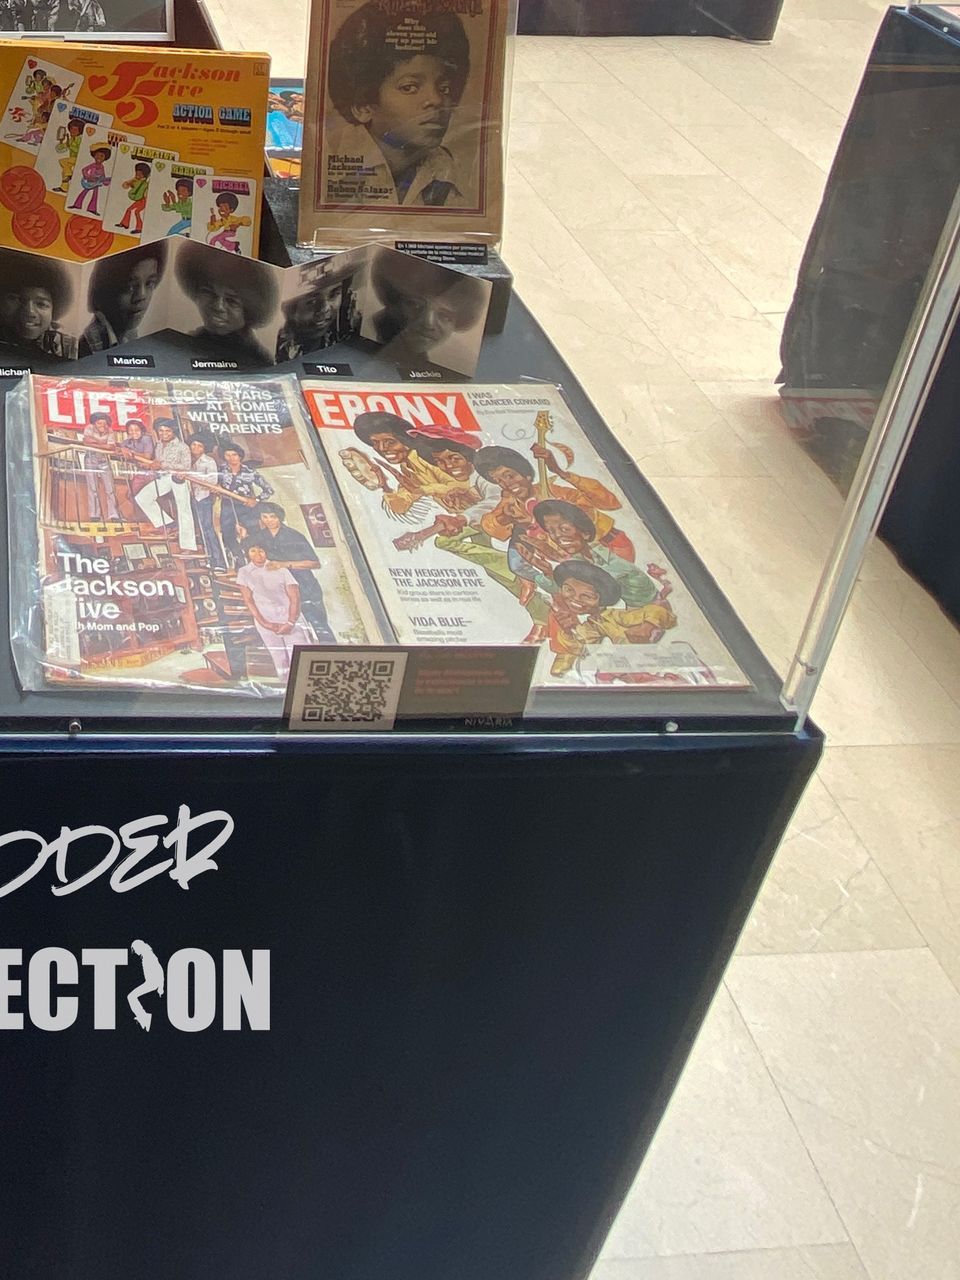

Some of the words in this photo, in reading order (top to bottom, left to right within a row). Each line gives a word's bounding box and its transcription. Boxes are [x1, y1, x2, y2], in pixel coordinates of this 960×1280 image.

[172, 103, 215, 125] ACTION
[218, 106, 252, 128] GAME
[327, 154, 364, 164] Michael
[113, 356, 148, 366] Marlon
[192, 360, 238, 369] Jermaine
[316, 365, 338, 374] Tito
[409, 370, 442, 379] Jackie
[173, 389, 218, 401] ROCK
[222, 390, 273, 401] STARS
[47, 388, 143, 426] LIFE
[206, 401, 224, 411] AT
[230, 401, 277, 412] HOME
[480, 399, 514, 407] CANCER
[312, 393, 462, 429] EBONY
[187, 411, 229, 422] WITH
[233, 412, 280, 423] THEIR
[210, 423, 283, 434] PARENTS
[57, 552, 110, 574] The
[388, 568, 413, 577] NEW
[415, 568, 457, 577] HEIGHTS
[459, 568, 478, 577] FOR
[392, 578, 414, 587] THE
[416, 578, 462, 587] JACKSON
[463, 578, 485, 587] FIVE
[75, 598, 121, 619] ive
[87, 622, 114, 631] Mom
[116, 622, 136, 631] and
[138, 622, 160, 632] Pop
[408, 616, 437, 627] VIDA
